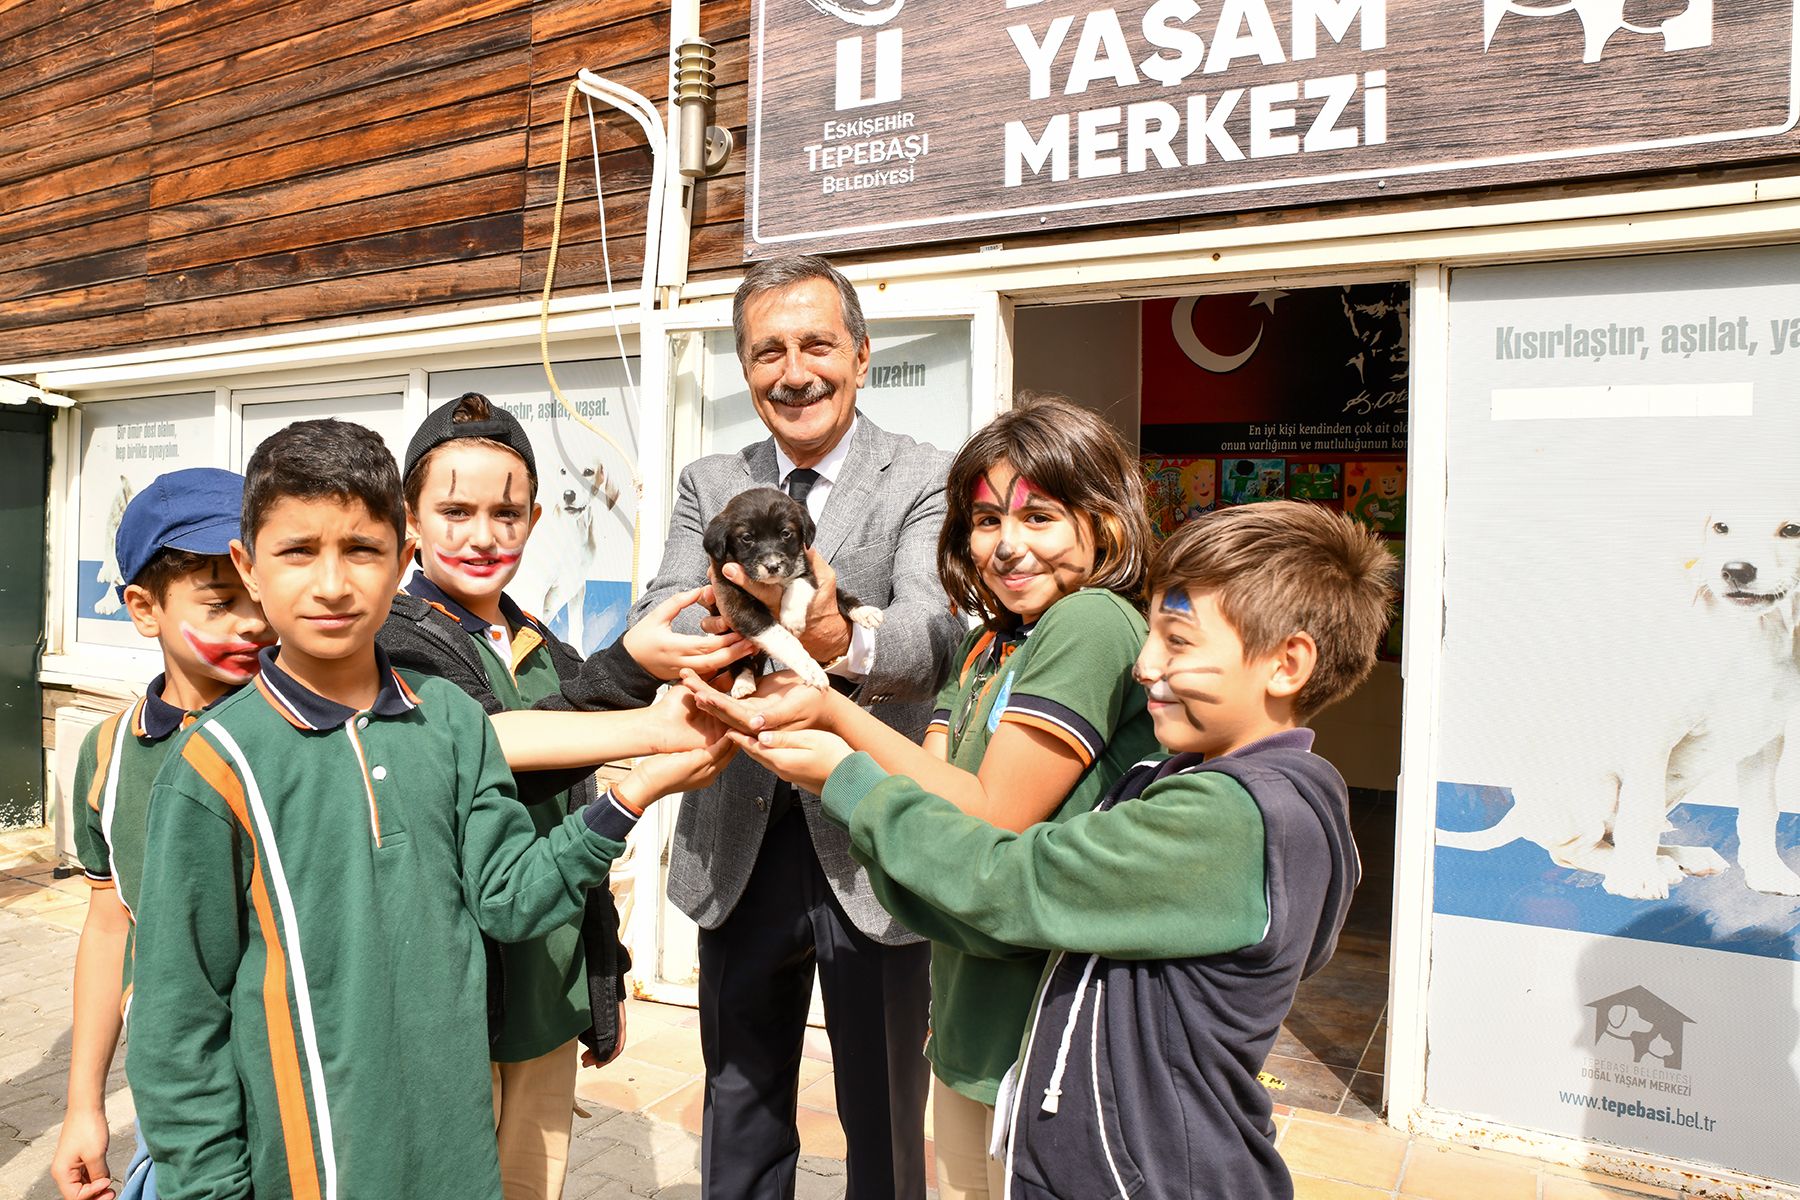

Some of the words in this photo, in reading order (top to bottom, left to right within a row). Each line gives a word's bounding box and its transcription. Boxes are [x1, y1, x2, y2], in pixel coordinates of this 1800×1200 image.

[1005, 0, 1387, 100] YAŞAM
[1004, 69, 1388, 188] MERKEZİ
[1495, 322, 1650, 363] Kısırlaştır,
[1660, 315, 1758, 359] aşılat,
[871, 361, 926, 388] uzatın
[1221, 440, 1247, 451] onun
[1249, 438, 1298, 454] varlığının
[1300, 440, 1313, 450] ve
[1315, 438, 1389, 454] mutluluğunun
[1249, 424, 1262, 436] En
[1264, 424, 1277, 438] iyi
[1279, 423, 1297, 438] kişi
[1299, 422, 1352, 436] kendinden
[1354, 421, 1373, 437] çok
[1375, 421, 1390, 434] ait
[1581, 1066, 1612, 1082] DOĞAL
[1614, 1072, 1647, 1089] YAŞAM
[1649, 1079, 1692, 1097] MERKEZİ
[1559, 1090, 1717, 1133] www.tepebasi.bel.tr
